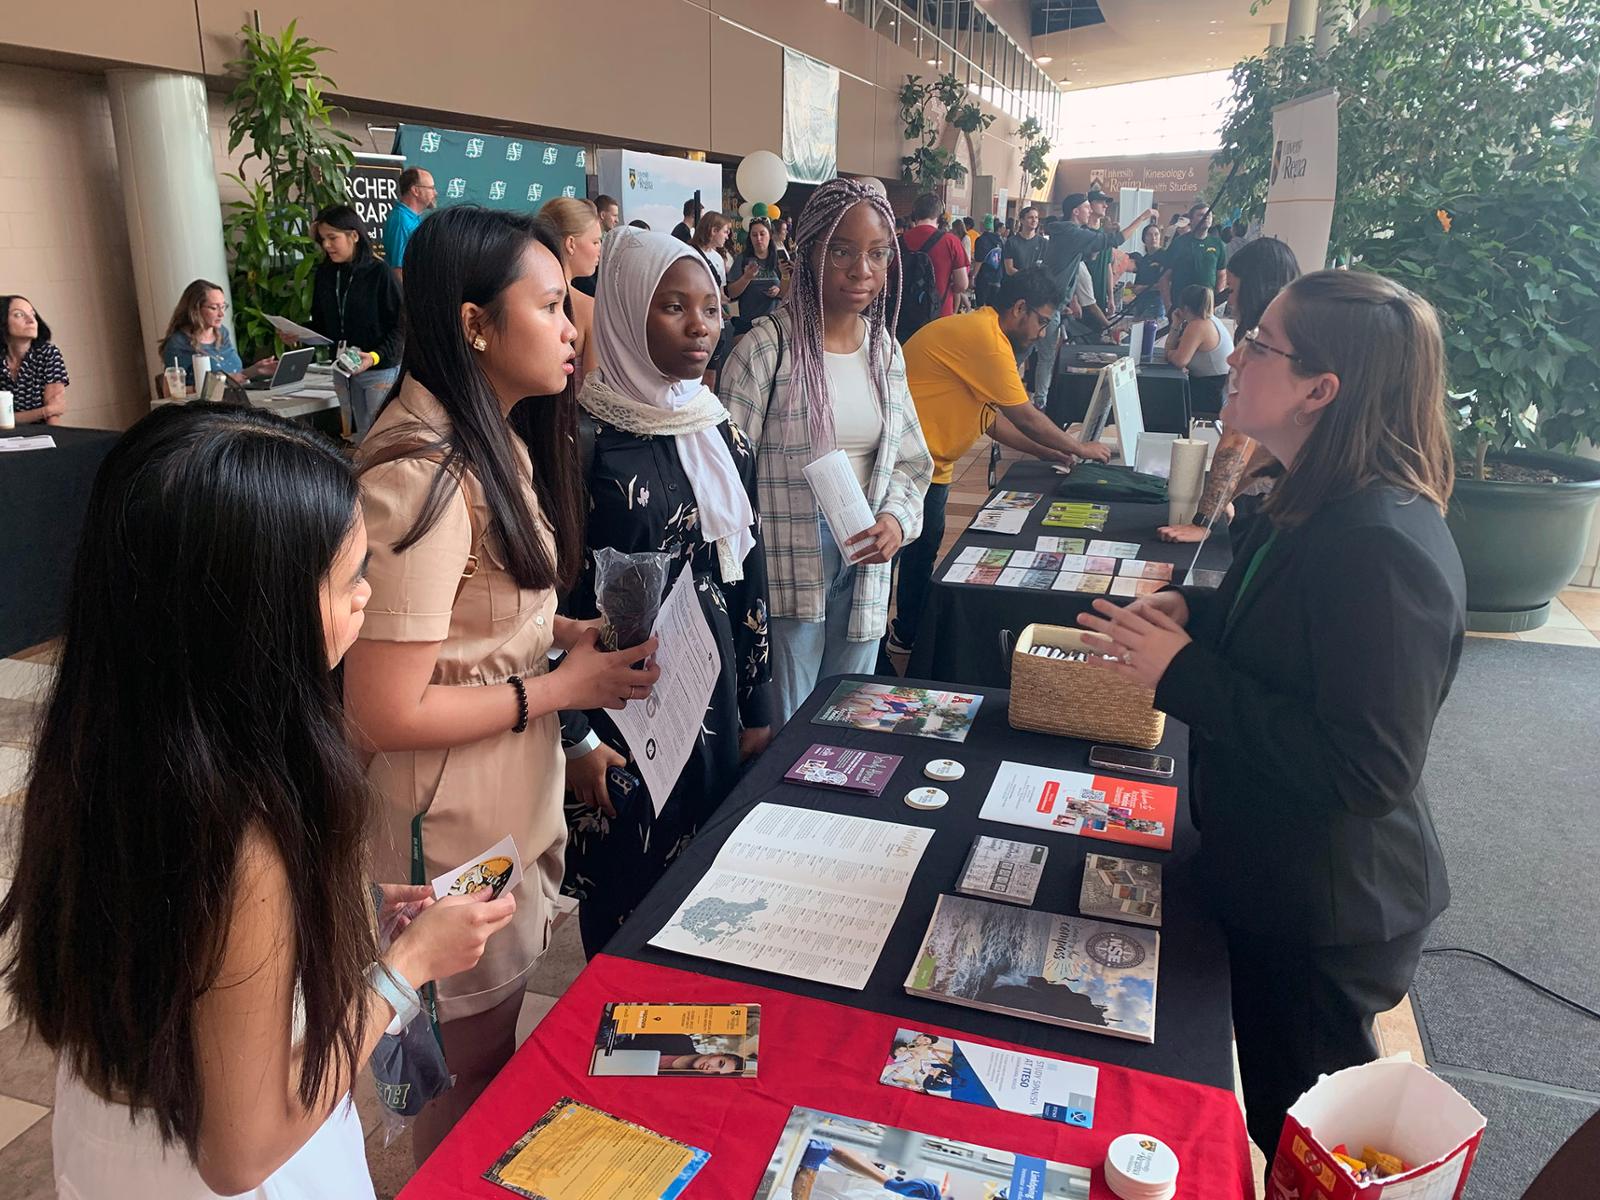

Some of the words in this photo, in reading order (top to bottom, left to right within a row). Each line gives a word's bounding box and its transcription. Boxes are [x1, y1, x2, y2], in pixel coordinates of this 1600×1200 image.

[1146, 167, 1186, 180] Kinesiology
[1169, 181, 1197, 192] Studies
[1051, 922, 1071, 961] compass
[1106, 937, 1123, 964] NSE
[1024, 1058, 1033, 1067] AT
[1033, 1061, 1044, 1079] STUDY
[1020, 1067, 1032, 1088] ITESO
[1029, 1080, 1041, 1106] SPANISH
